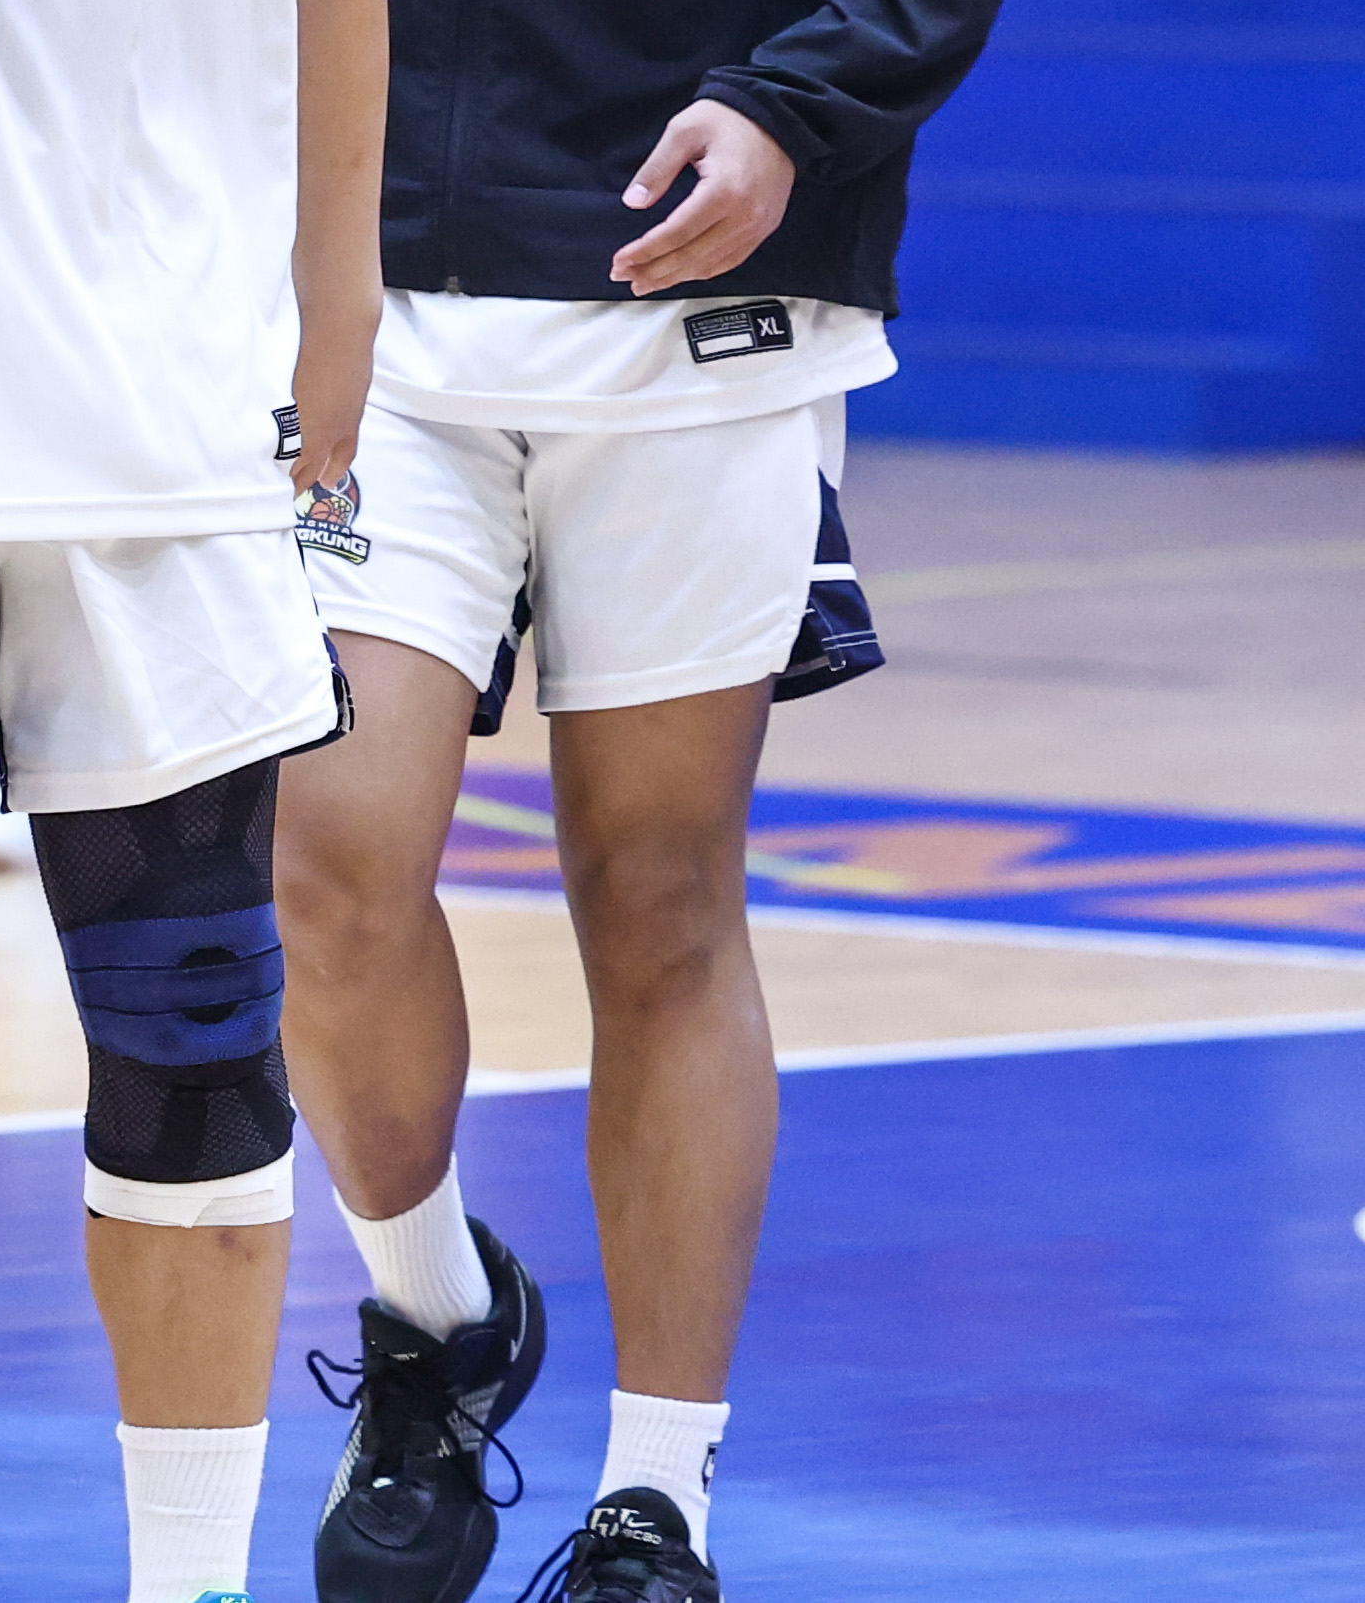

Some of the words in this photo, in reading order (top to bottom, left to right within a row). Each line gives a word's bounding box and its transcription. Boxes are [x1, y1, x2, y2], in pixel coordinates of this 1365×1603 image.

[757, 316, 785, 337] XL
[298, 519, 351, 534] NGHUA
[295, 528, 368, 556] GKUNG
